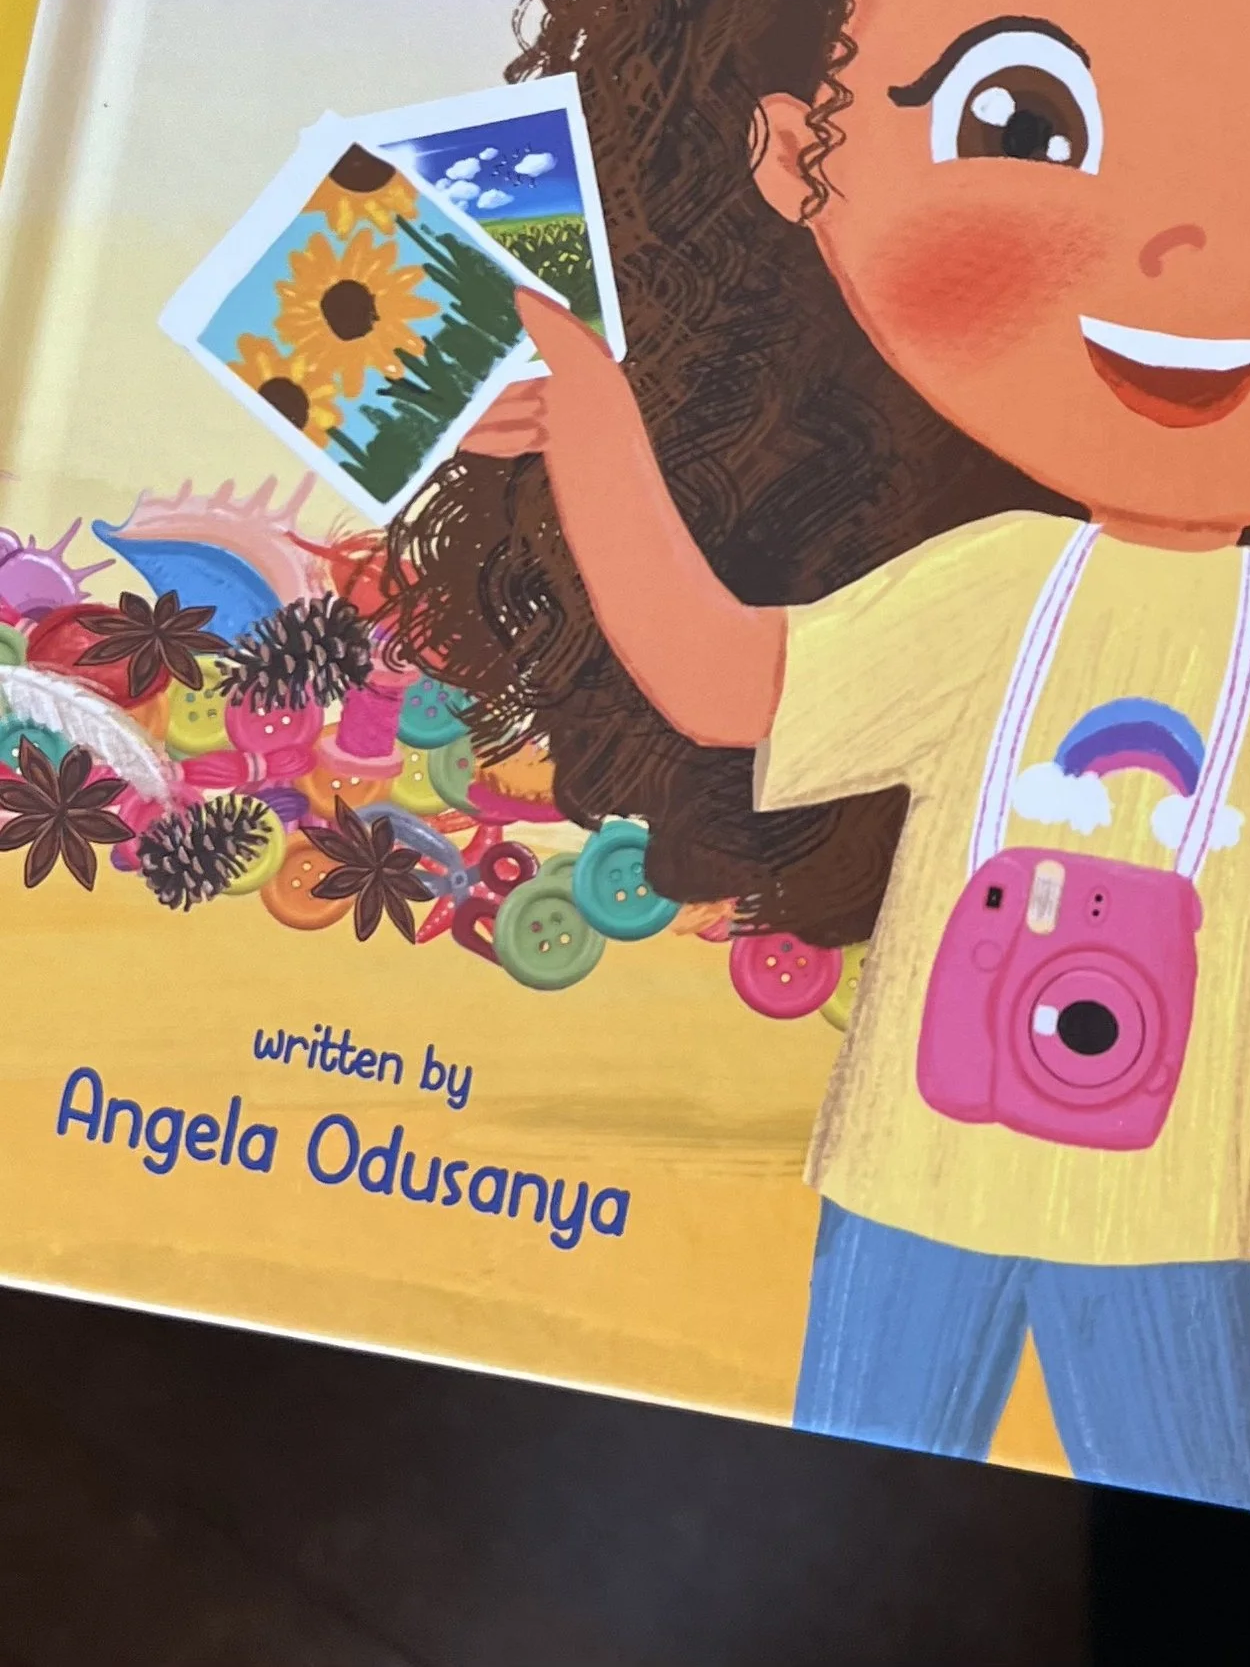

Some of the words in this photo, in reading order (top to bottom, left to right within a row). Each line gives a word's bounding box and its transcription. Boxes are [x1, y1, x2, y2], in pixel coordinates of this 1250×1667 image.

[254, 1024, 402, 1085] written
[419, 1045, 472, 1109] by
[57, 1067, 278, 1174] Angela
[307, 1114, 630, 1250] Odusanya
